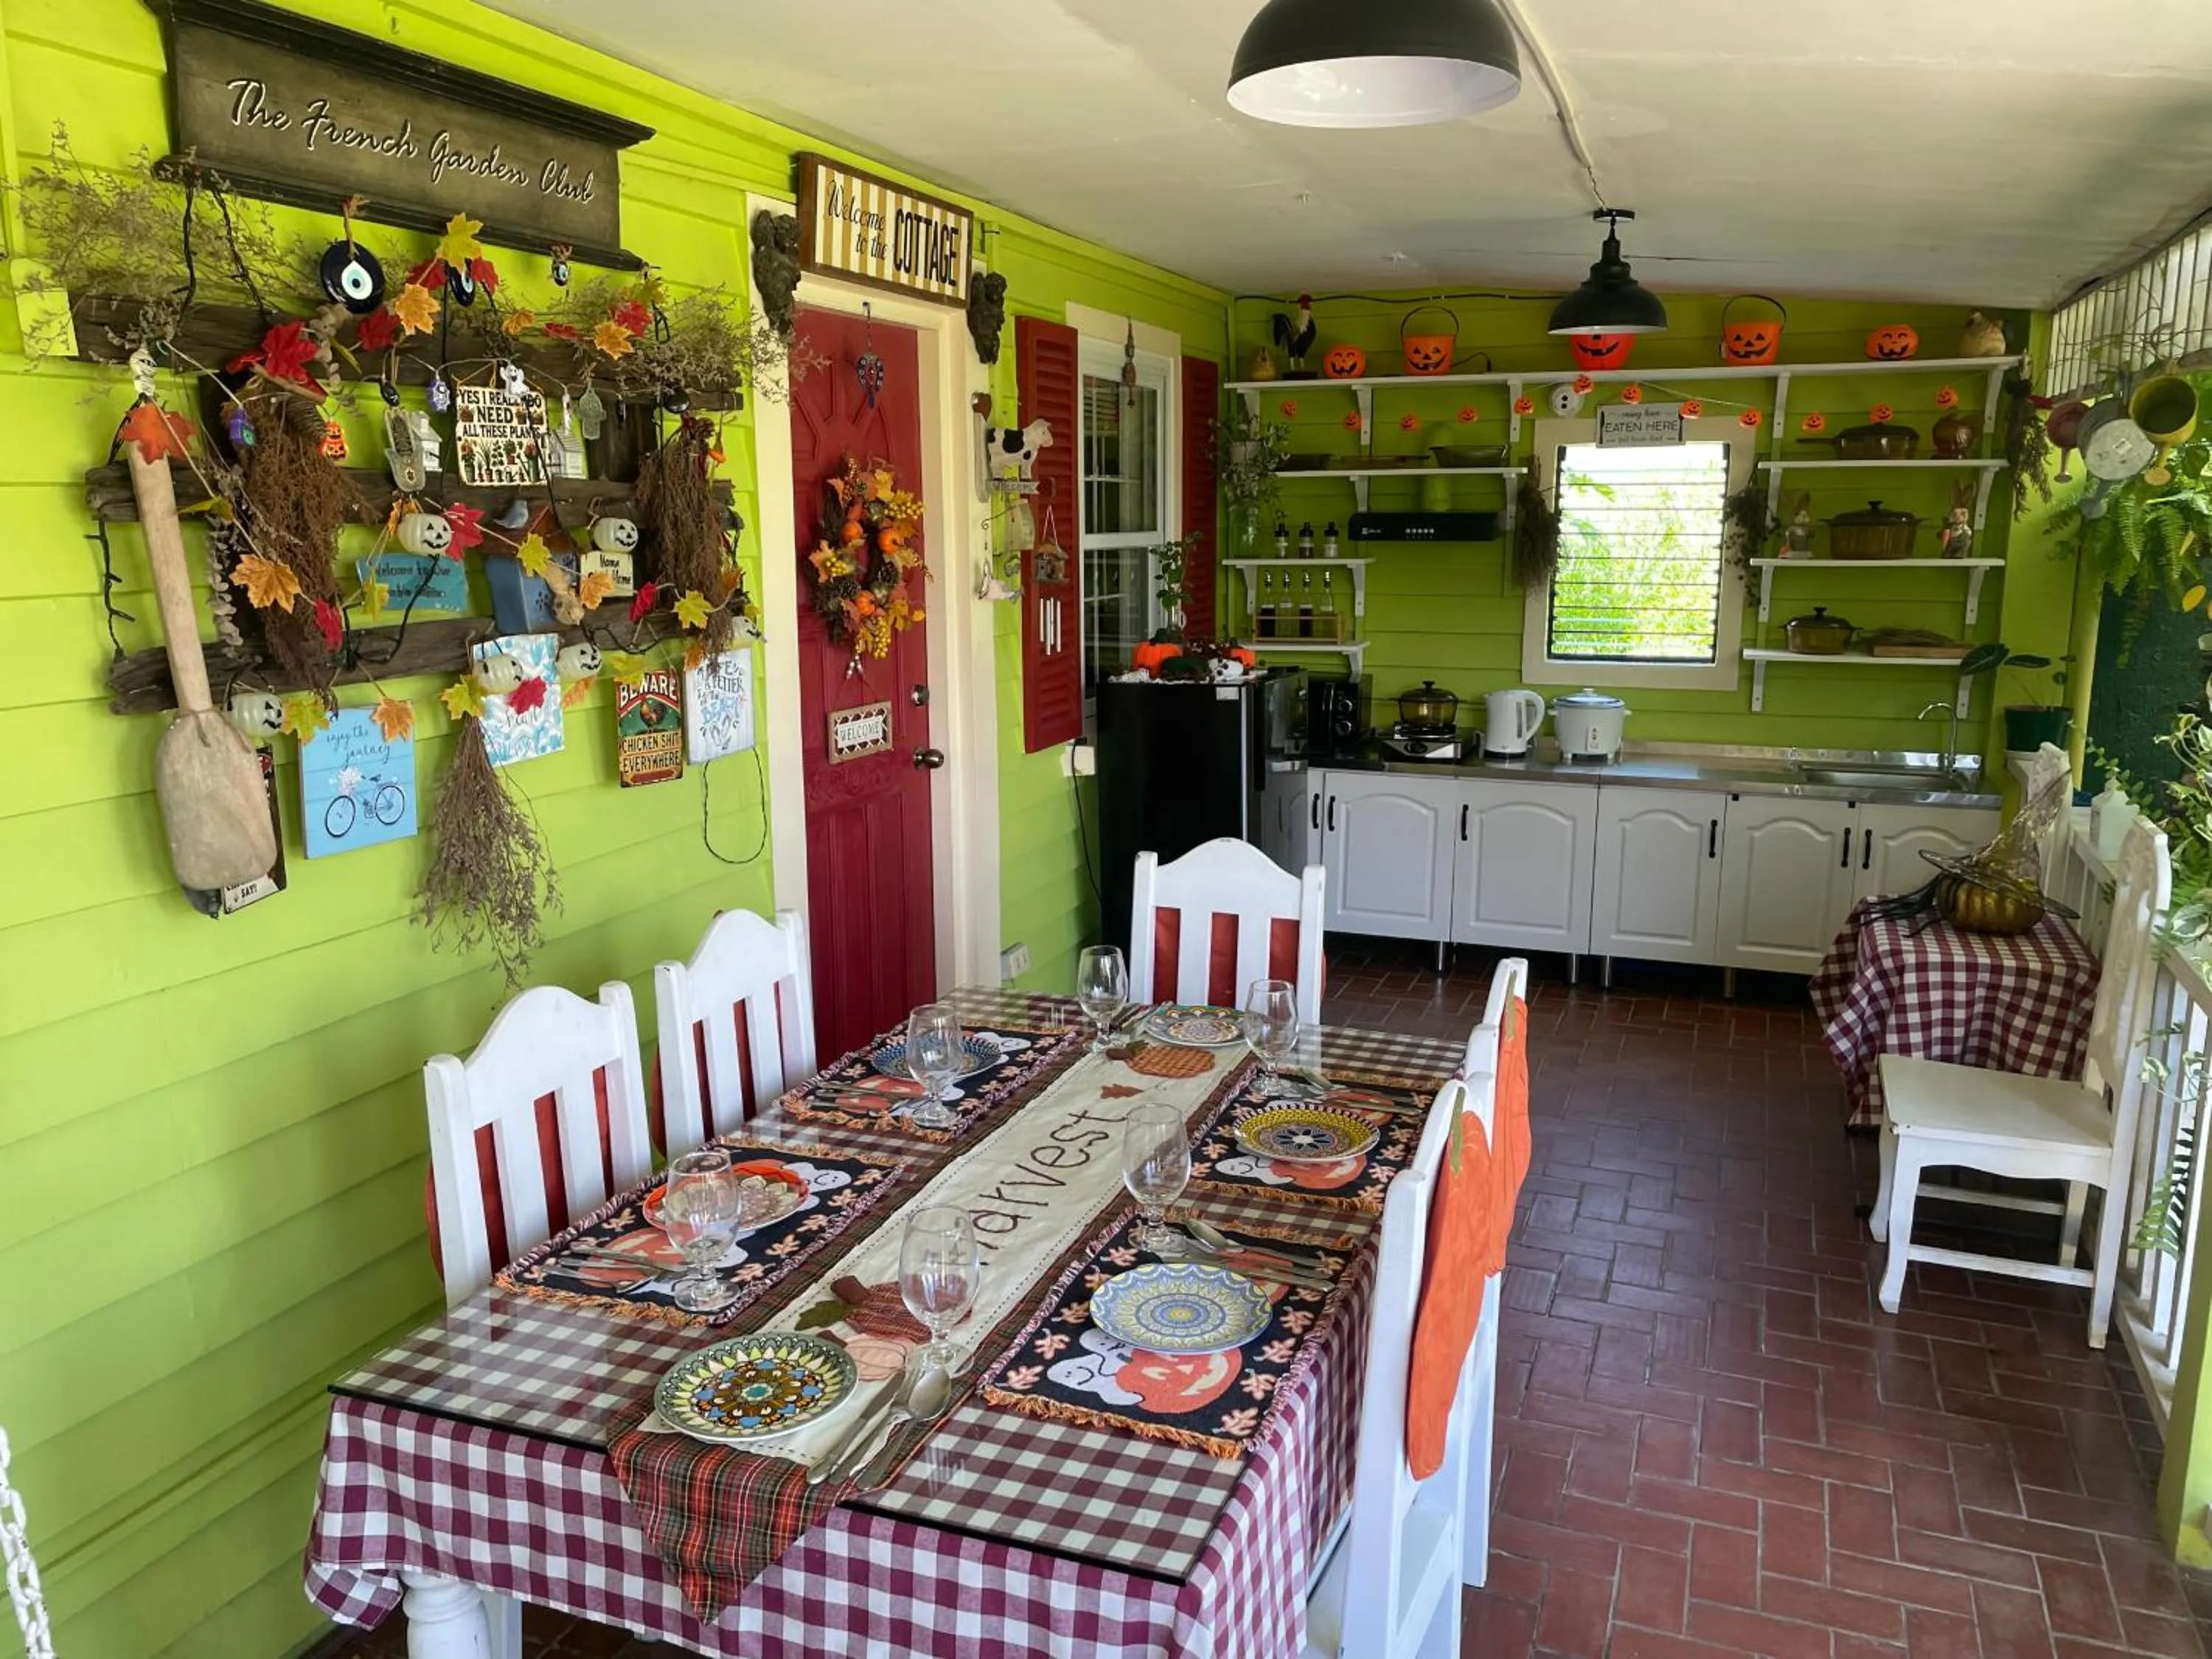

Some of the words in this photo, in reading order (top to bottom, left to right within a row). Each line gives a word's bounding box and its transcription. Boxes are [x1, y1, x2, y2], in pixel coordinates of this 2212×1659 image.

[226, 79, 293, 131] The
[301, 98, 419, 159] French
[429, 129, 529, 186] Garden
[539, 158, 595, 204] Club
[828, 179, 886, 232] Welcome
[855, 231, 868, 254] to
[870, 236, 888, 260] the
[894, 208, 959, 287] COTTAGE
[459, 389, 480, 404] YES
[482, 390, 487, 405] I
[489, 391, 523, 406] REAL
[476, 406, 514, 424] NEED
[1604, 422, 1642, 433] EATEN
[1645, 419, 1678, 431] HERE
[463, 424, 479, 437] ALL
[479, 424, 508, 439] THESE
[840, 720, 882, 742] WELCOME
[622, 736, 659, 754] CHICKEN
[661, 732, 681, 748] SHIT
[623, 751, 681, 773] EVERYWHERE
